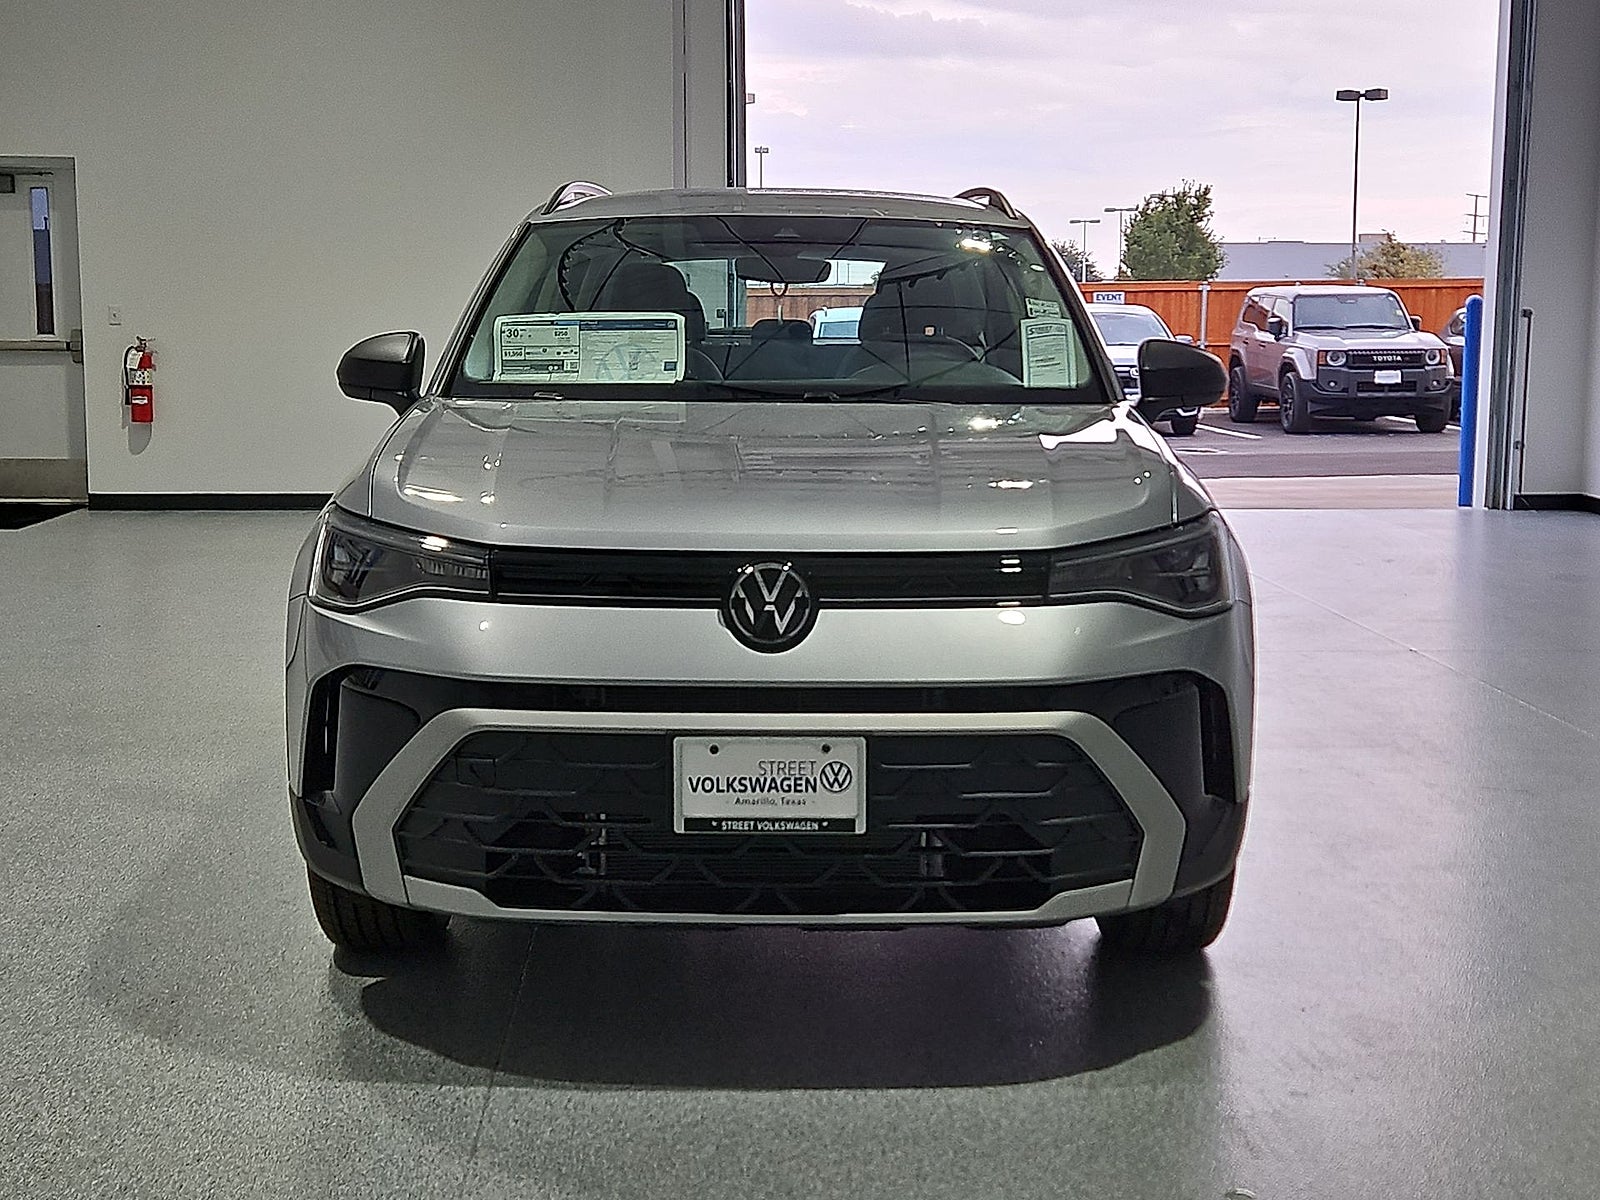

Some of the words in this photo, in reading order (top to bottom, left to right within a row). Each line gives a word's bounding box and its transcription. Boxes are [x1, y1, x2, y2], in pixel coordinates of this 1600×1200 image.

[1096, 293, 1123, 302] EVENT
[506, 328, 519, 338] 30
[758, 760, 817, 776] STREET
[688, 776, 817, 793] VOLKSWAGEN
[734, 797, 778, 806] Amarillo,
[781, 797, 807, 806] Texas
[721, 821, 754, 831] STREET
[756, 821, 819, 831] VOLKSWAGEN
